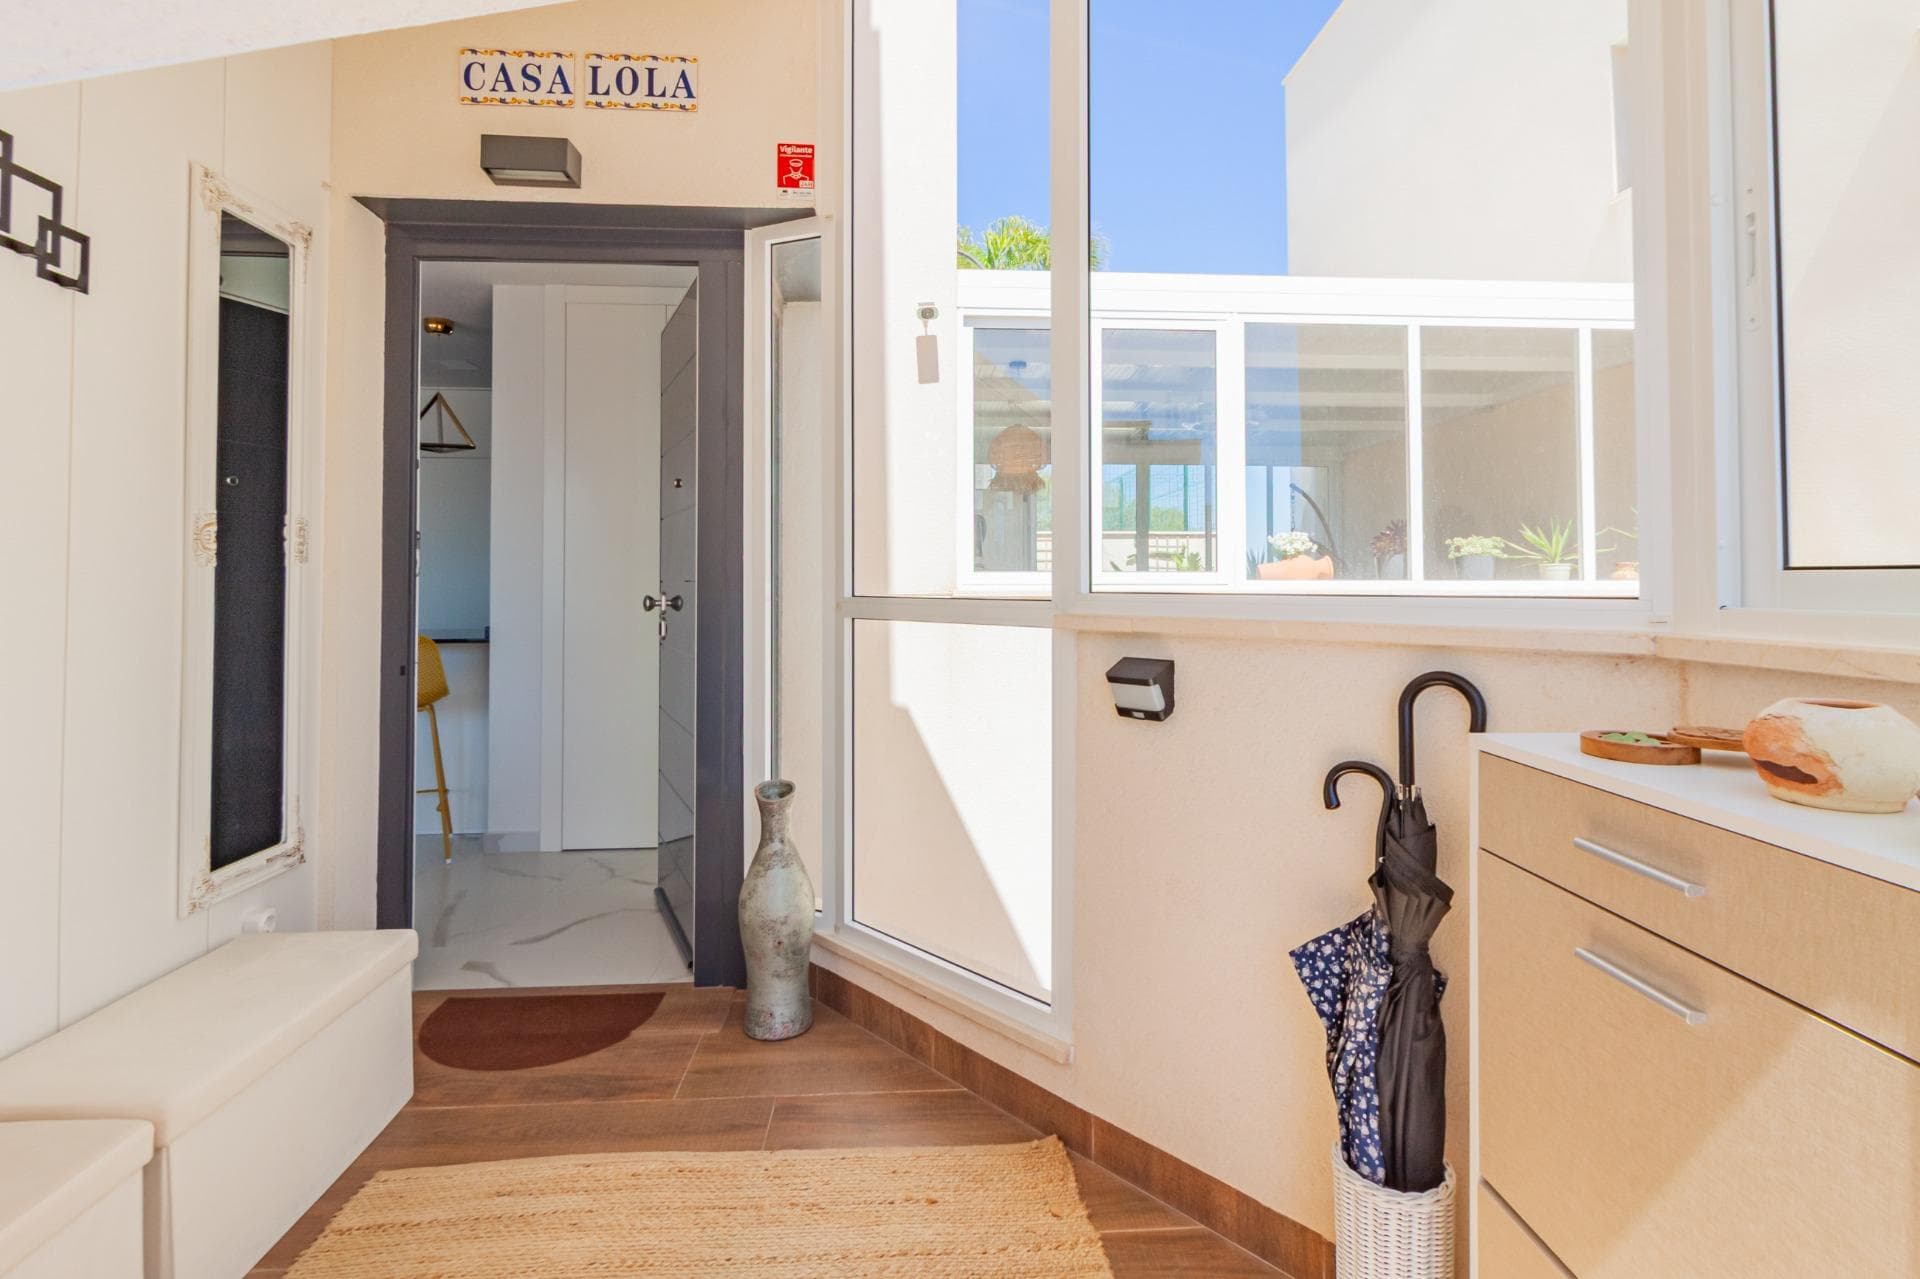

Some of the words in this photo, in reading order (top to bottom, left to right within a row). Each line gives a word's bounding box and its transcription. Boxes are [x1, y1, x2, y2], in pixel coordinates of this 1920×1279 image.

[463, 61, 573, 95] CASA
[588, 65, 696, 98] LOLA
[779, 145, 813, 155] Vigilante
